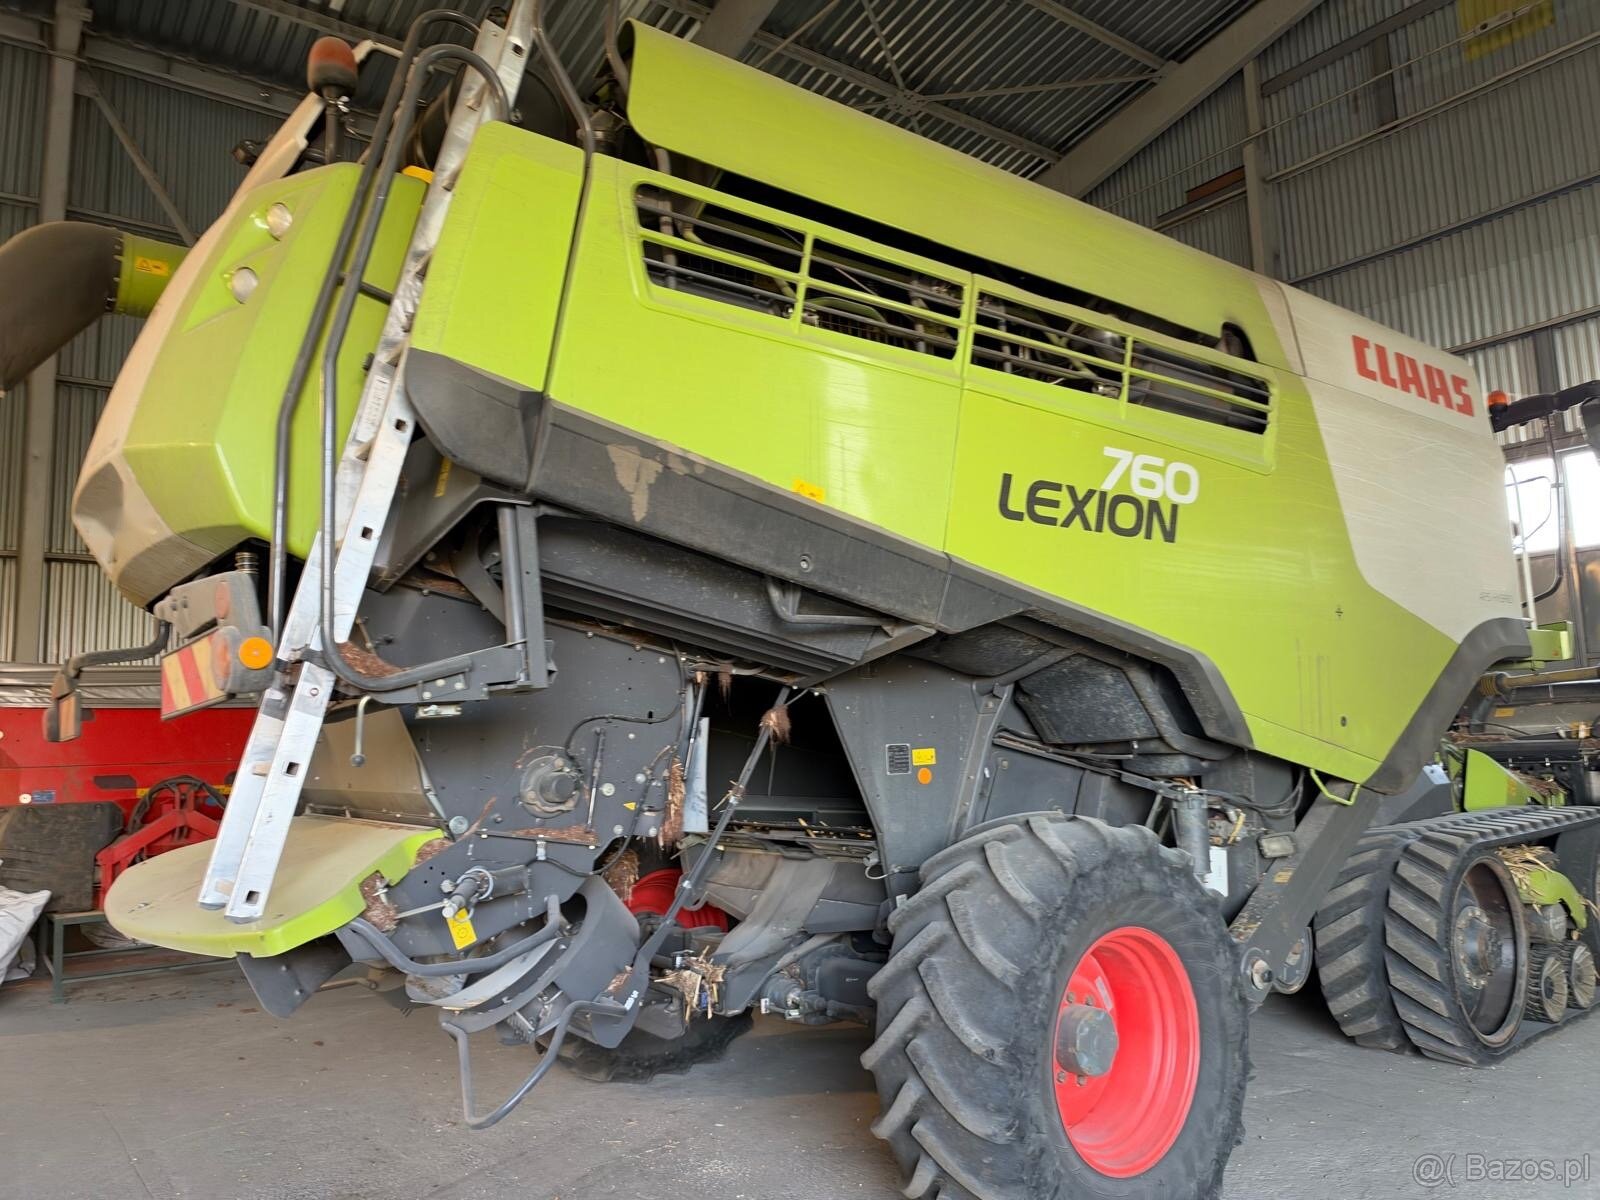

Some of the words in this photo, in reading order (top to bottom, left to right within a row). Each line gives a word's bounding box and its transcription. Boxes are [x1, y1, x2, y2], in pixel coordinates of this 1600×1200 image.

[1351, 334, 1474, 417] CLAAS
[998, 472, 1178, 543] LEXION
[1100, 446, 1200, 505] 760
